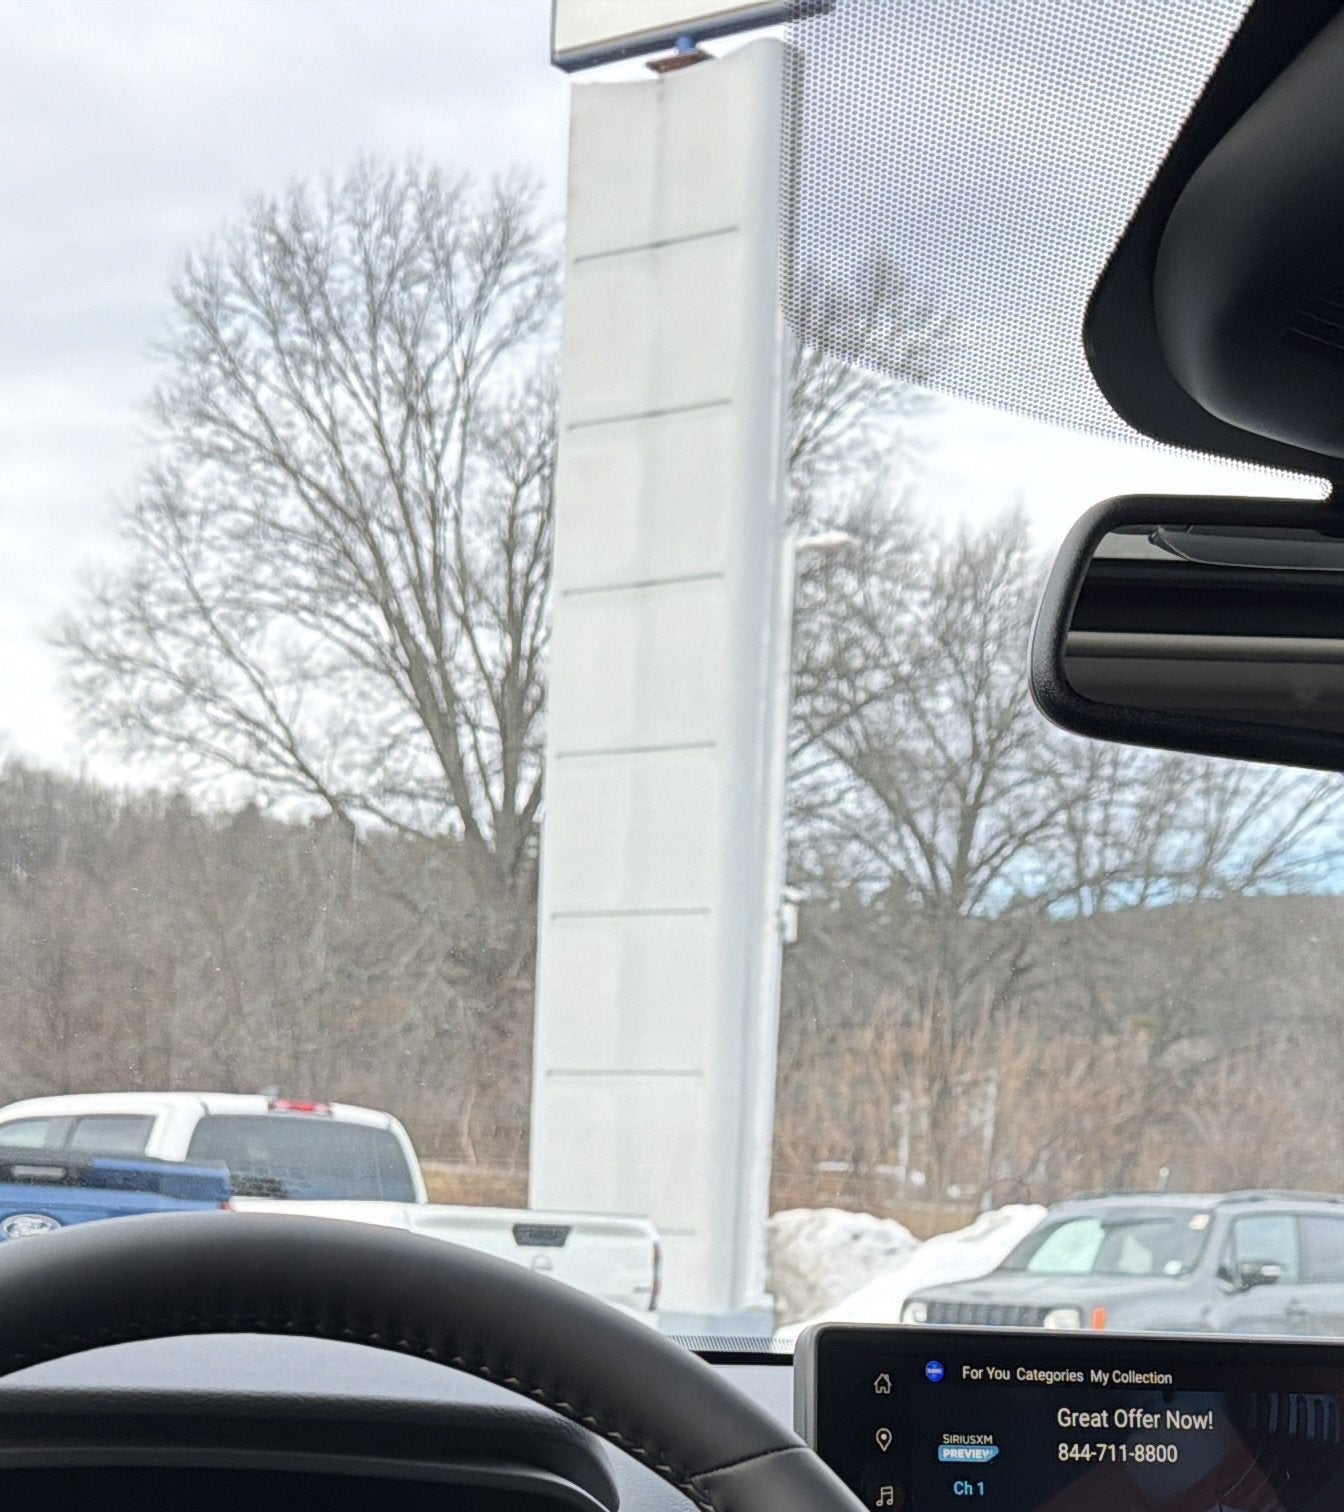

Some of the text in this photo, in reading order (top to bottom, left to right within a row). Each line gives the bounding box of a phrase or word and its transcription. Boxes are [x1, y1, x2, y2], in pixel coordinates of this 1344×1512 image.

[962, 1366, 1173, 1386] For You Categories My Collection
[1057, 1408, 1213, 1430] Great Offer Now!
[943, 1448, 990, 1459] PREVIEW
[1058, 1443, 1178, 1463] 844-711-8800
[953, 1481, 984, 1496] Ch 1
